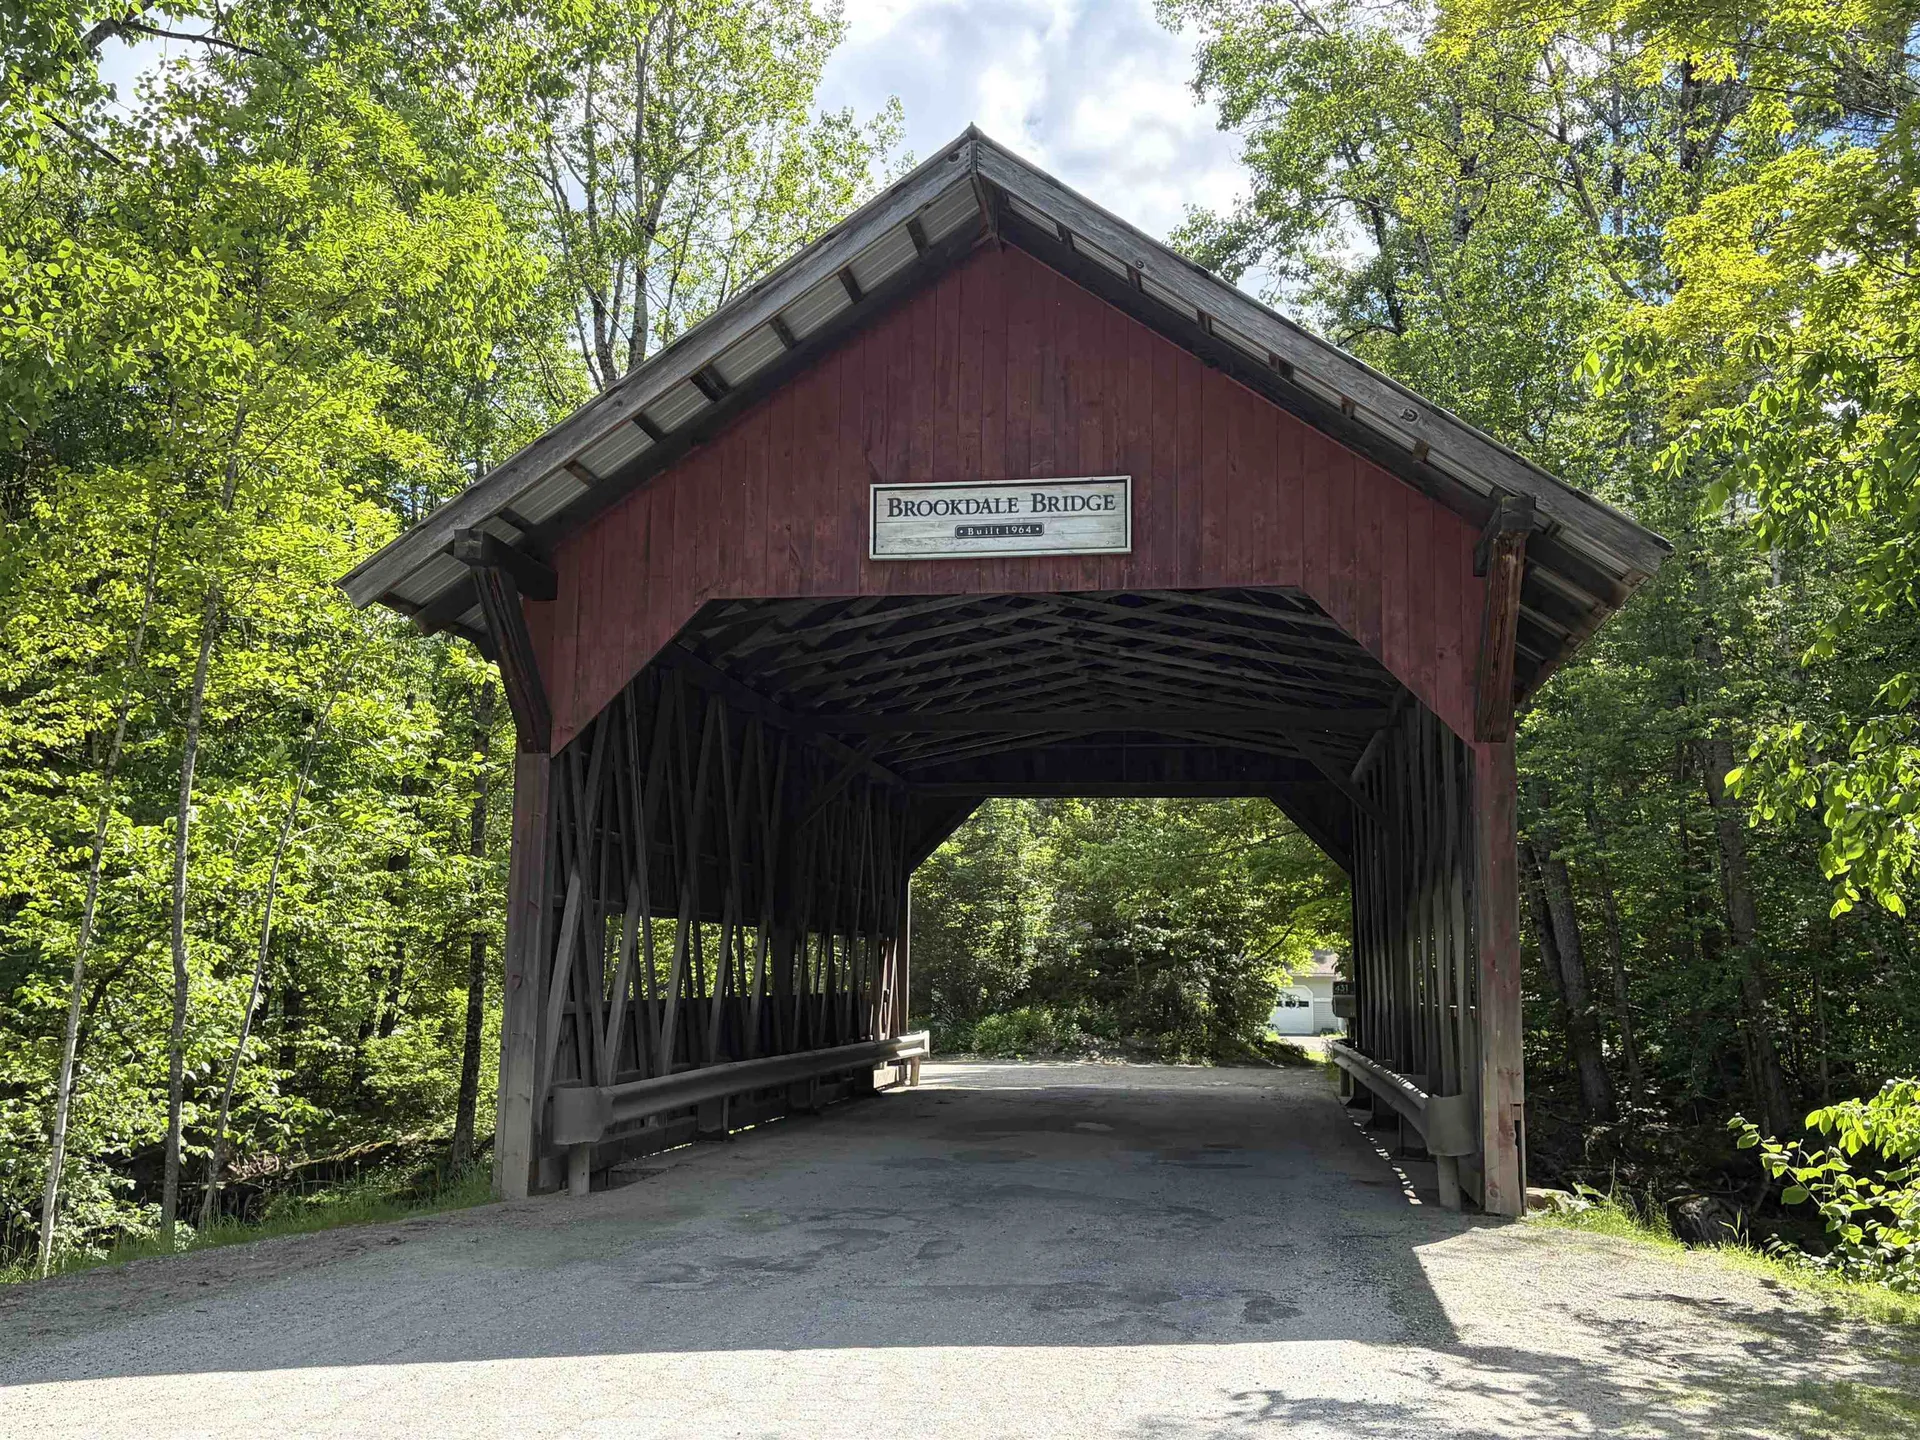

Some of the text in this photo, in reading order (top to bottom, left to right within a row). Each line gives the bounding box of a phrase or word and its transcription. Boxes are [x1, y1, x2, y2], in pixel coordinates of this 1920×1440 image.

[887, 493, 1116, 517] BROOKDALE BRIDGE
[967, 525, 1032, 536] Built 1964
